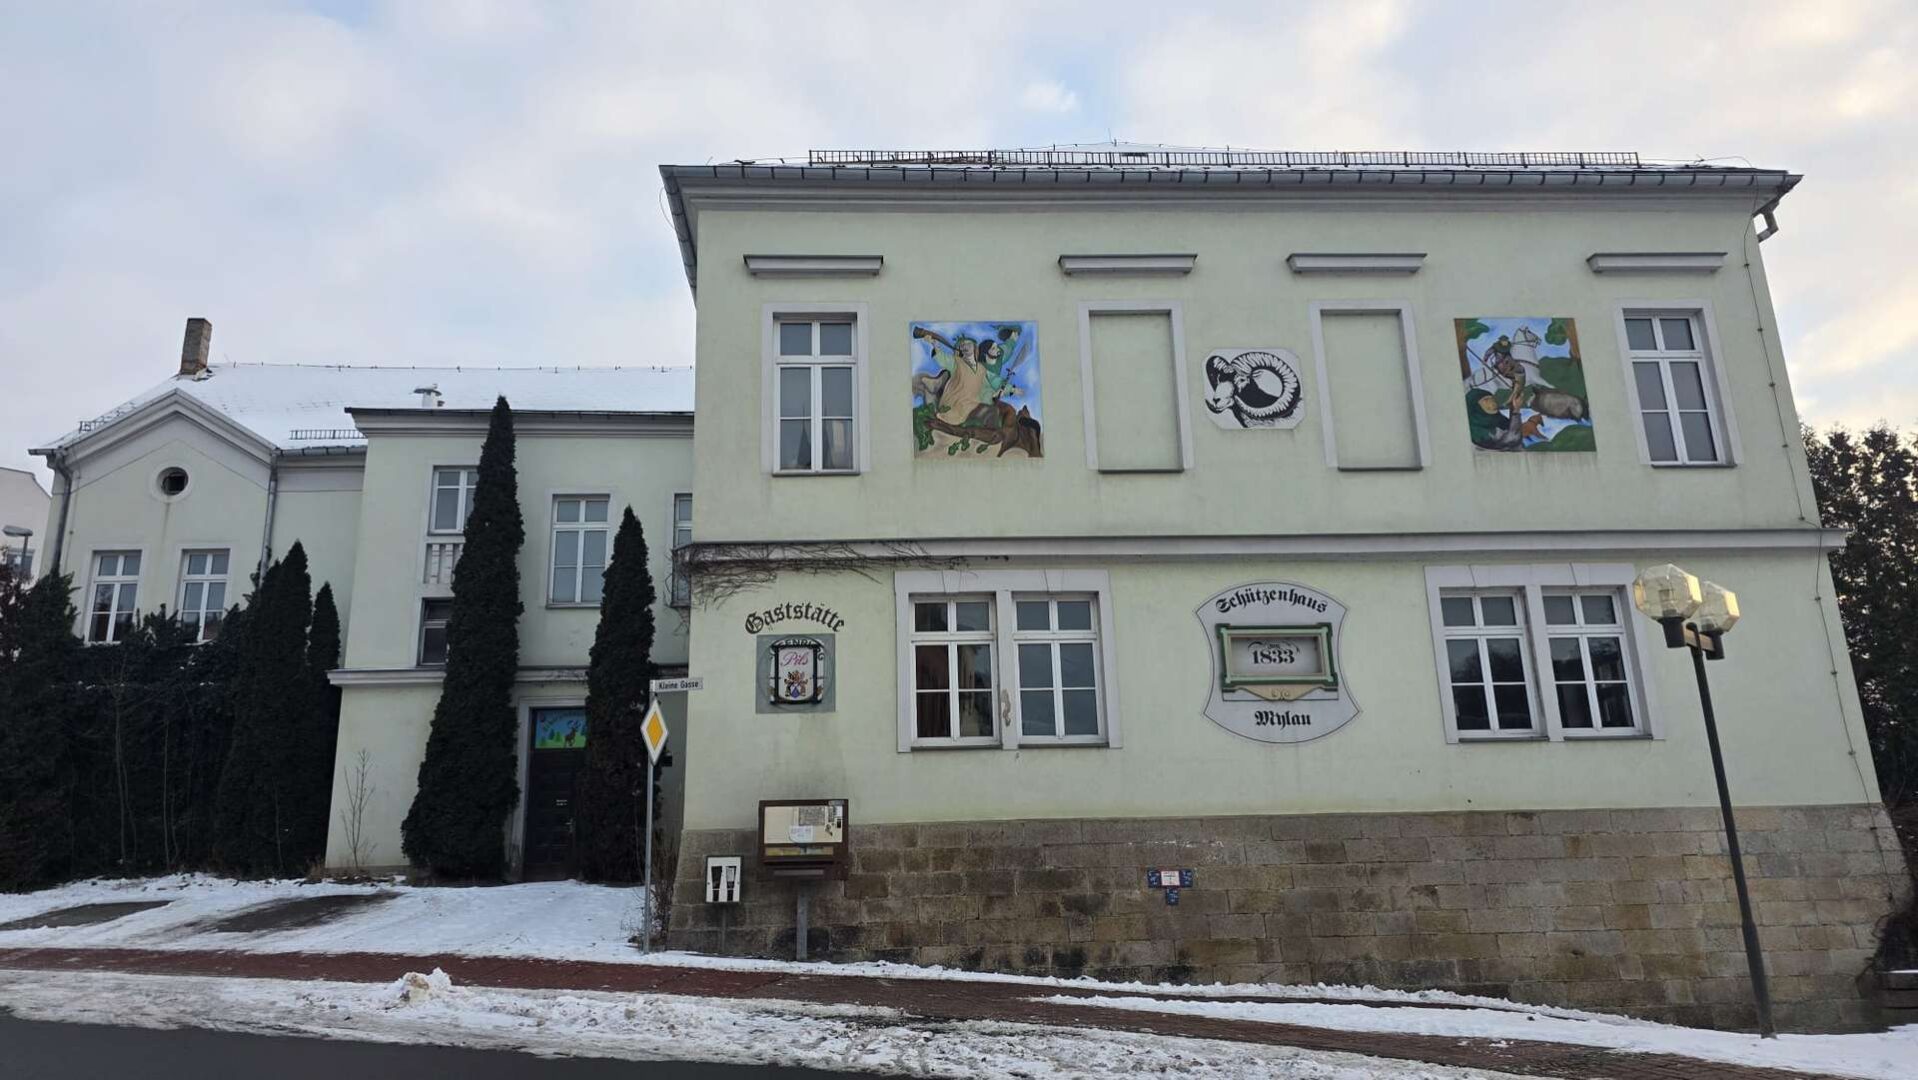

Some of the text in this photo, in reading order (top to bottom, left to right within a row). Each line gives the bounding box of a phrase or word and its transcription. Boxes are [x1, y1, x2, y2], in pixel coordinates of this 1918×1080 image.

[1216, 588, 1328, 613] Schützenhaus
[745, 602, 845, 634] Gaststätte
[780, 651, 809, 667] Pils
[1253, 650, 1295, 664] 1833
[659, 680, 699, 690] Kleine Gasse
[1255, 710, 1311, 730] Mylau
